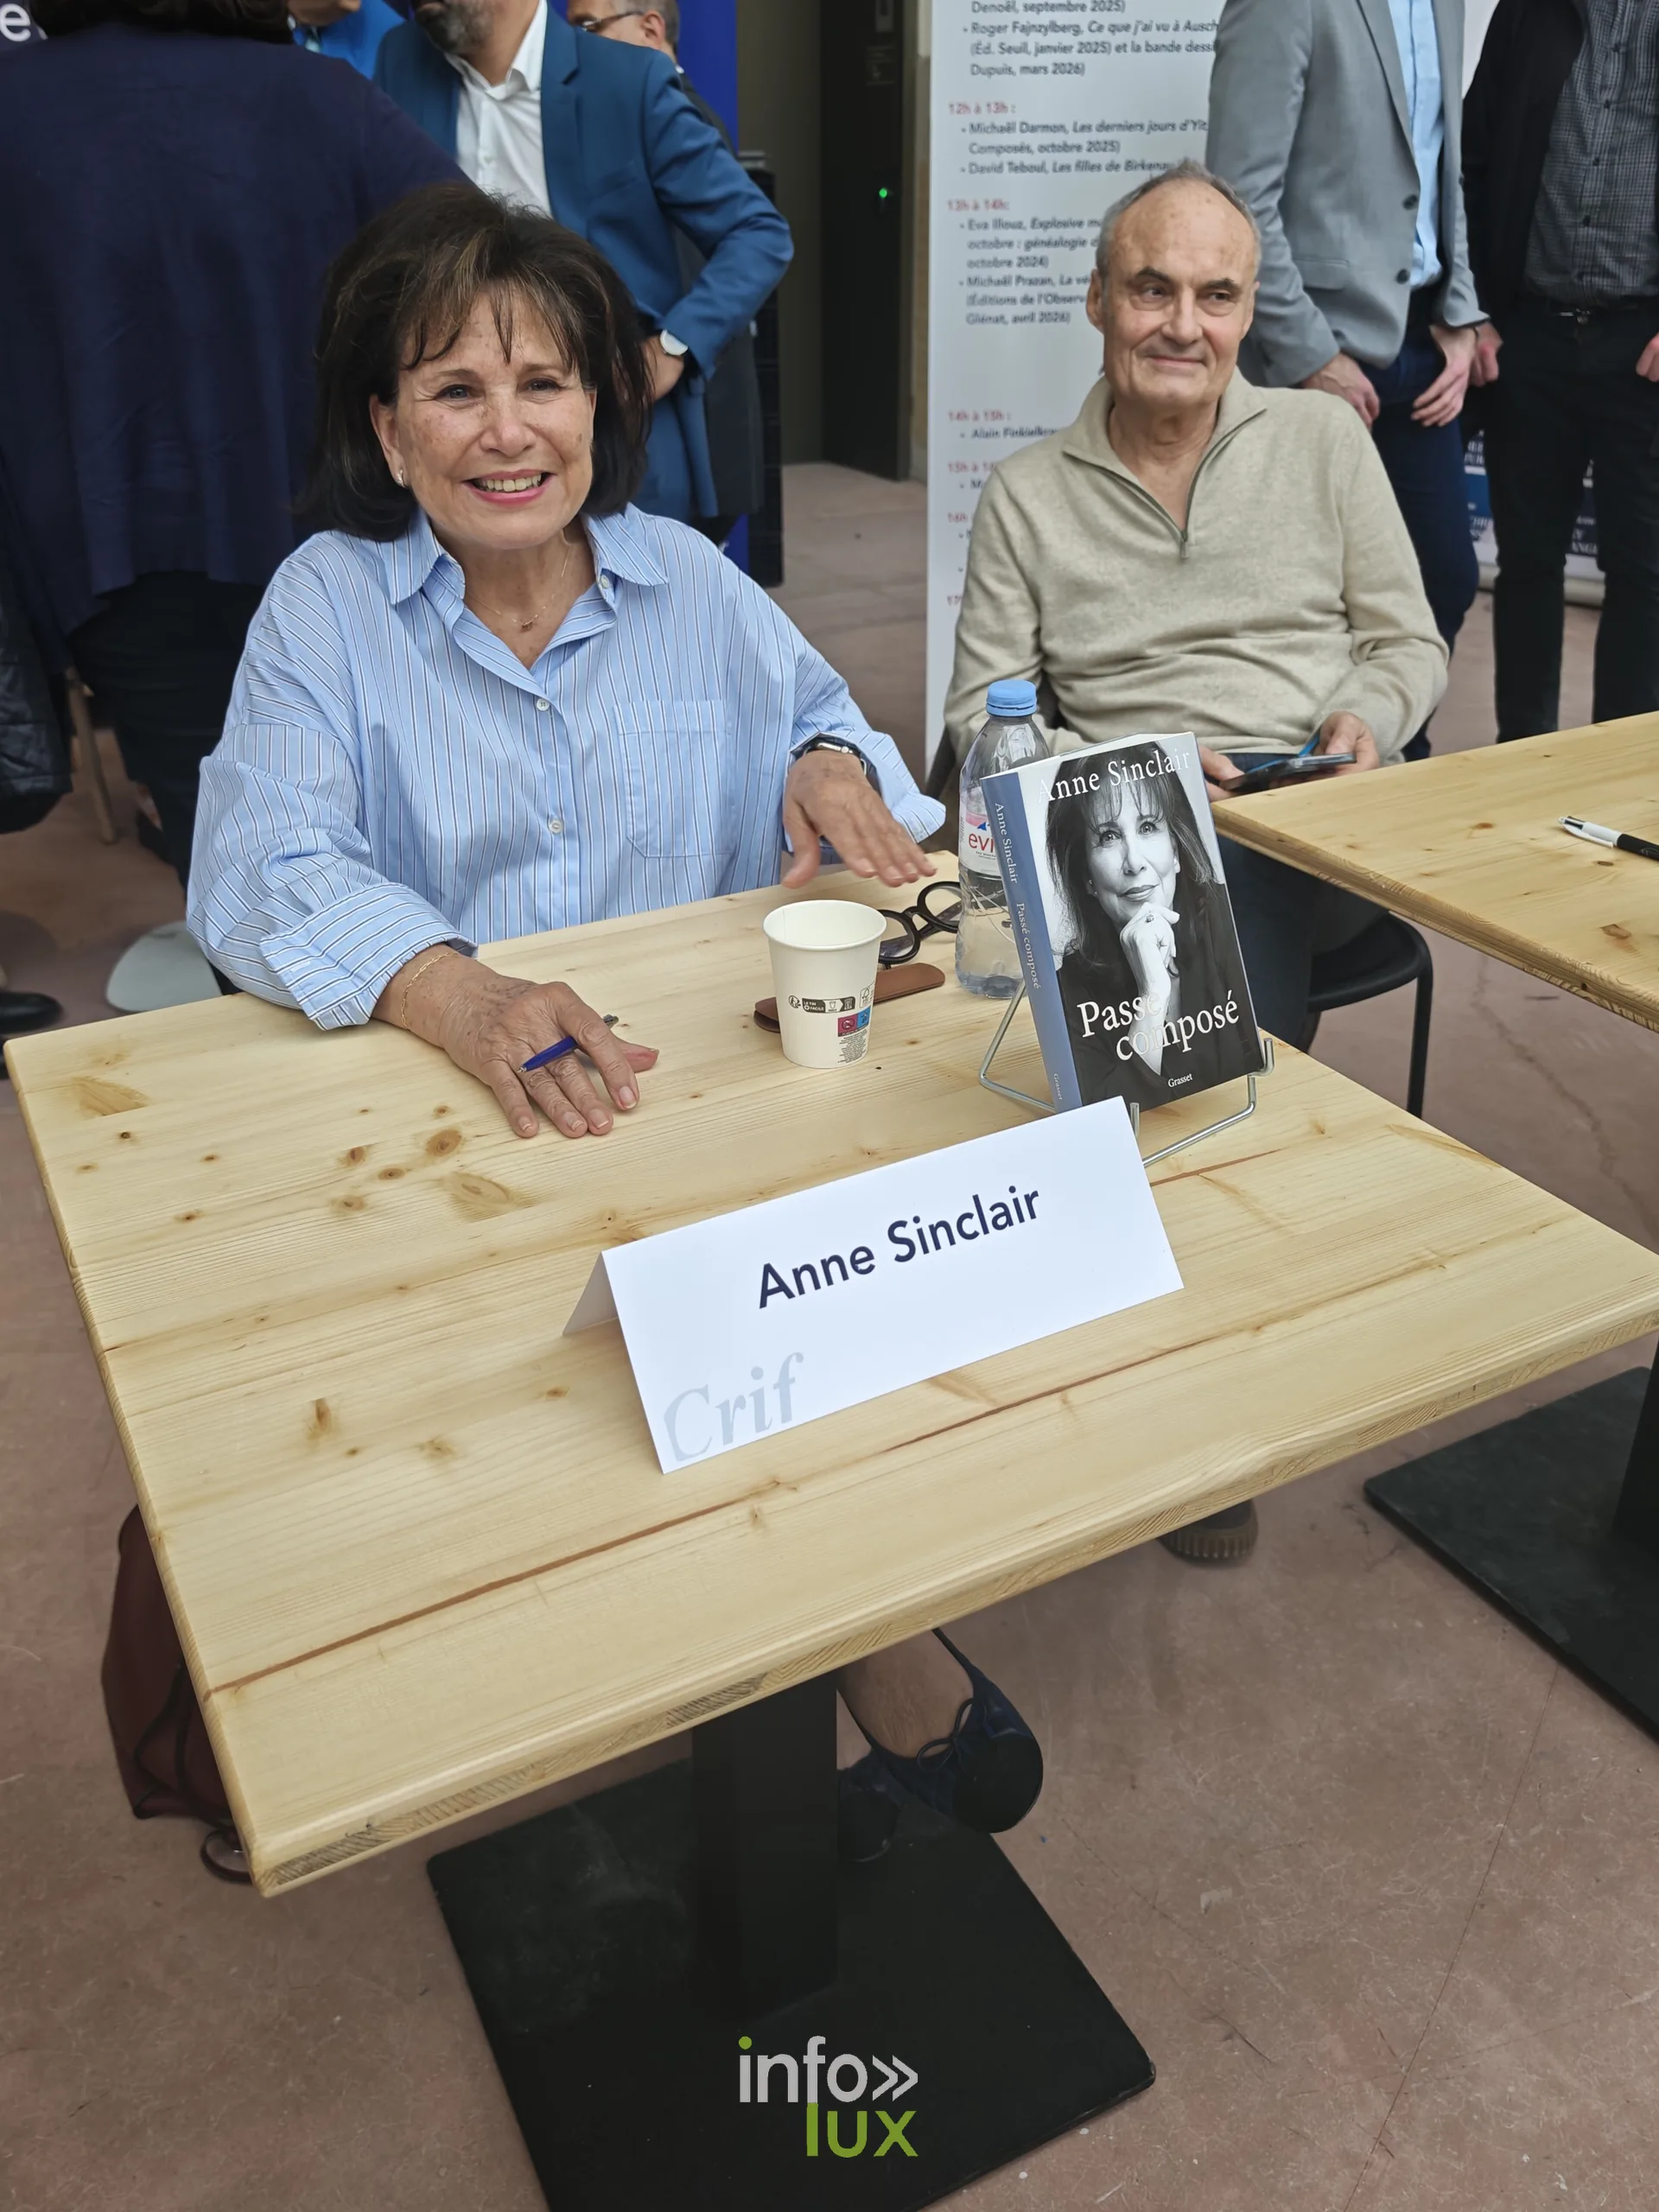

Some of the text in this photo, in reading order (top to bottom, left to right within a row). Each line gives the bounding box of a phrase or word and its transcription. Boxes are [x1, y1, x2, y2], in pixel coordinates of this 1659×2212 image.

[1022, 0, 1087, 16] septembre
[1090, 0, 1126, 13] 2025)
[971, 21, 1009, 37] Roger
[1088, 20, 1104, 33] Ce
[1108, 22, 1132, 35] que
[1134, 19, 1154, 35] j'ai
[1155, 22, 1171, 32] vu
[1173, 19, 1180, 32] à
[998, 41, 1032, 55] Seuil,
[1033, 41, 1074, 57] janvier
[1077, 41, 1112, 55] 2025)
[1115, 42, 1128, 53] et
[1130, 40, 1142, 53] la
[1145, 40, 1183, 53] bande
[970, 62, 1085, 79] Dupuis, mars 2026)
[969, 121, 1017, 135] Michaël
[1020, 121, 1070, 135] Darmon,
[1072, 121, 1093, 133] Les
[1095, 119, 1145, 133] derniers
[1146, 119, 1176, 136] jours
[969, 139, 1122, 157] Composés, octobre 2025)
[969, 161, 1004, 175] David
[1006, 160, 1050, 175] Teboul,
[1052, 159, 1072, 174] Les
[1074, 159, 1103, 173] filles
[1105, 159, 1121, 172] de
[968, 219, 989, 231] Eva
[1030, 215, 1085, 232] Explosive
[967, 237, 1014, 251] octobre
[967, 256, 1049, 270] octobre 2024)
[967, 275, 1013, 288] Michaël
[1020, 293, 1035, 306] de
[1011, 310, 1036, 324] avril
[971, 427, 1001, 439] Alain
[1038, 747, 1190, 804] Anne Sinclair
[995, 802, 1018, 884] Anne Sinclair
[1016, 902, 1042, 990] Passé composé
[1116, 990, 1240, 1061] composé
[1054, 1073, 1063, 1101] Grasset
[1167, 1073, 1193, 1088] Grasset
[760, 1185, 1039, 1310] Anne Sinclair
[663, 1351, 804, 1462] Crif
